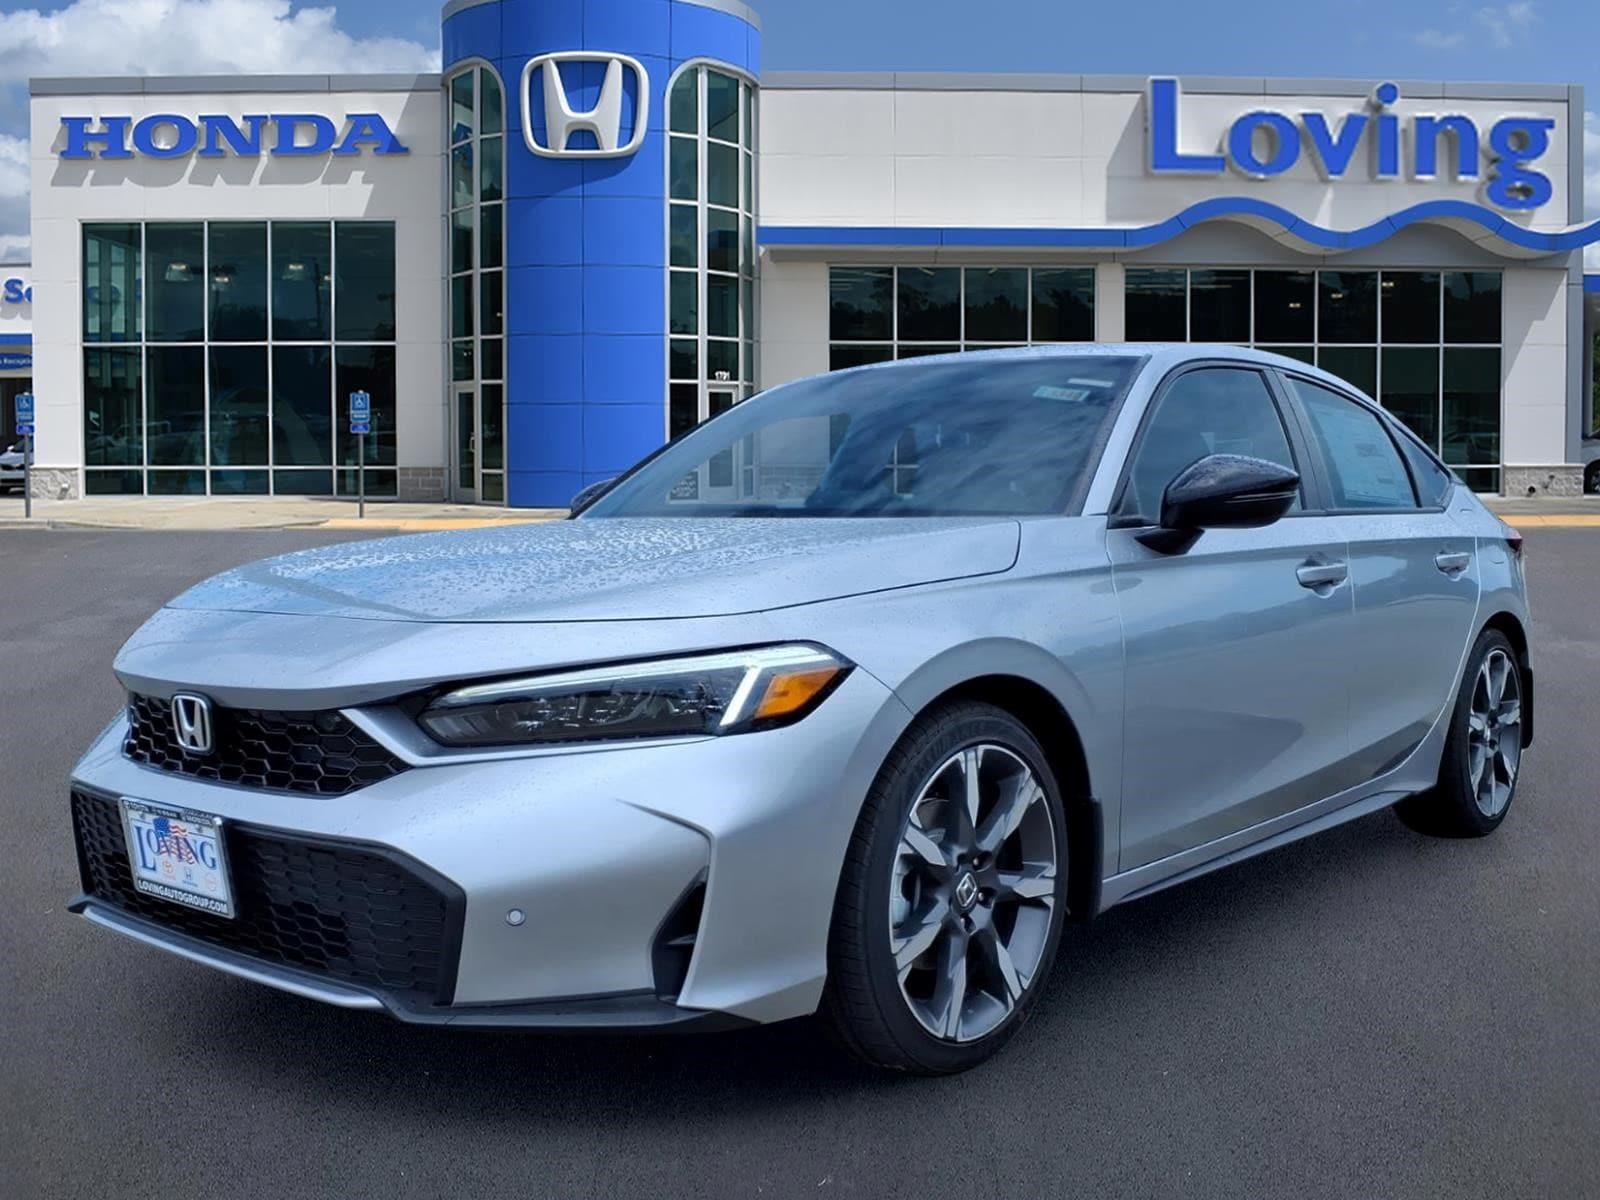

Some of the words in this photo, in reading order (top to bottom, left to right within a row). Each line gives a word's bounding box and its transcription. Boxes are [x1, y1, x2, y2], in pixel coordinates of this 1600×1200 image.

[59, 112, 410, 159] HONDA
[1149, 77, 1556, 210] Loving
[134, 825, 218, 872] LOVING
[138, 880, 229, 914] LOVINGAUTOGROUP.COM
